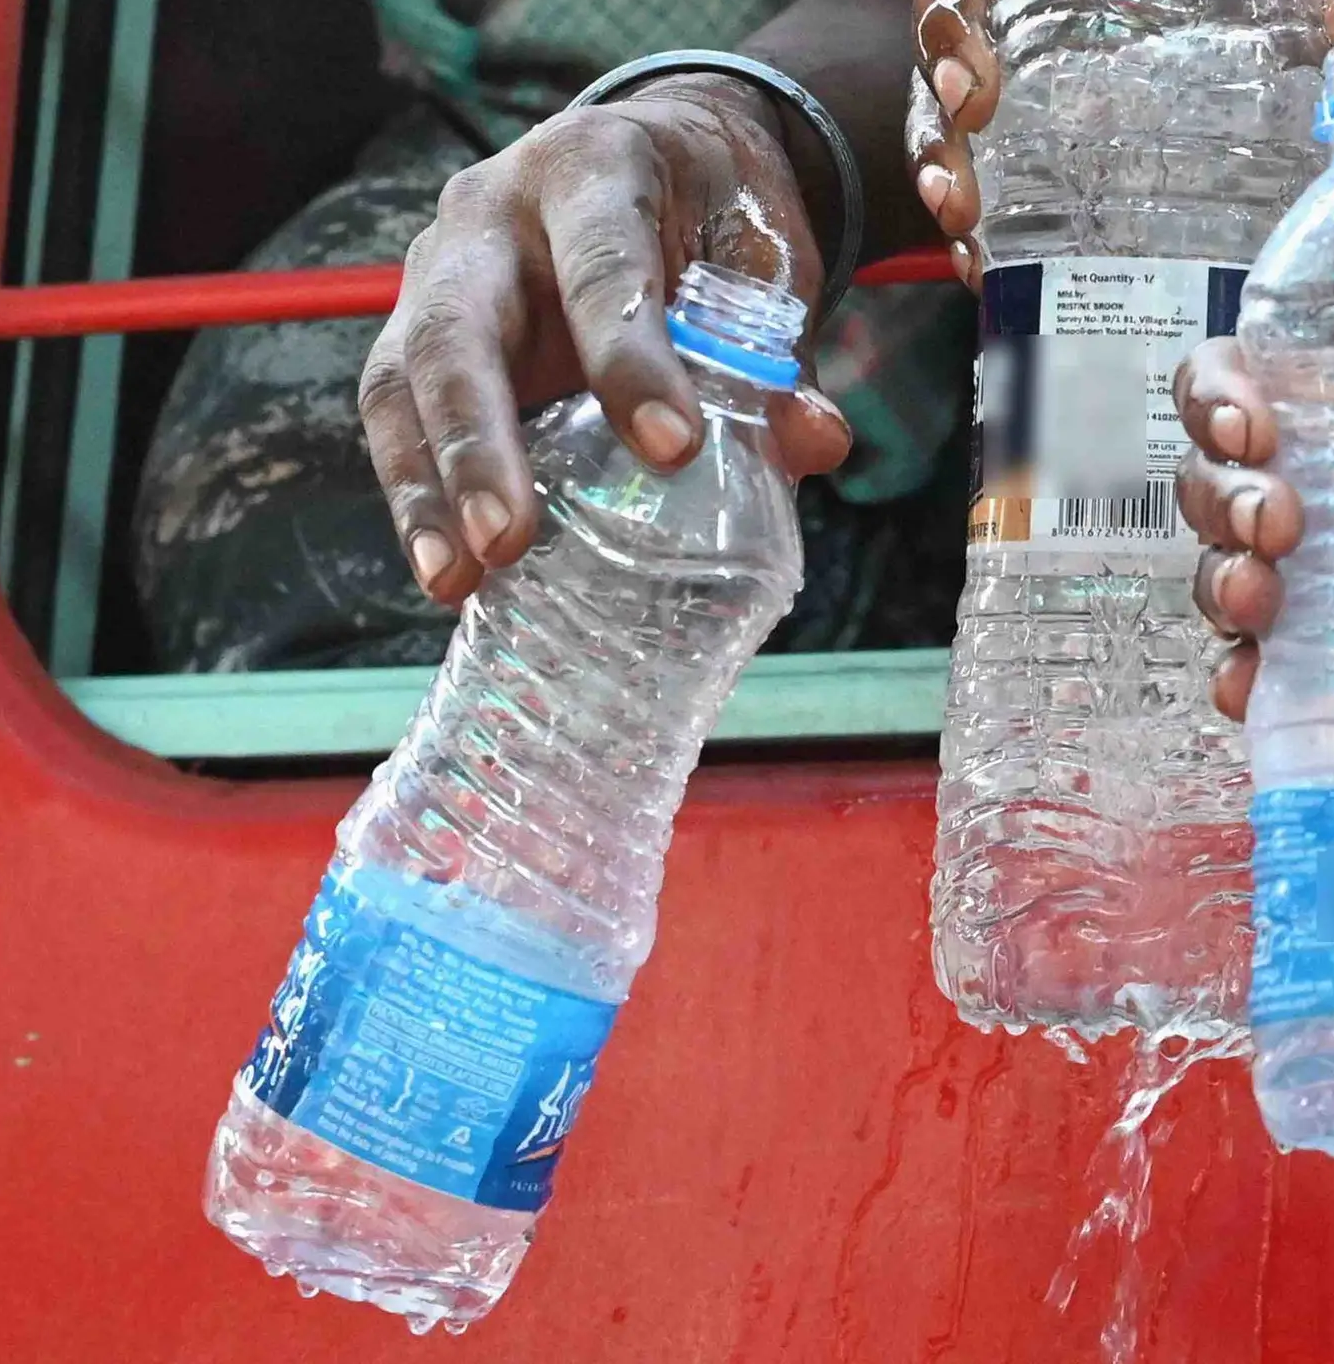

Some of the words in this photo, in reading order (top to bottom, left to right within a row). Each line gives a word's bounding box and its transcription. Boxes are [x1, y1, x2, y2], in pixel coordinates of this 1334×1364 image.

[1071, 273, 1087, 283] Net
[1089, 273, 1135, 285] Quantity
[1057, 302, 1091, 311] PRISTINE
[1093, 302, 1124, 311] BROOK
[1057, 316, 1082, 325] Survey
[1139, 316, 1168, 326] Village
[1052, 528, 1058, 537] 8
